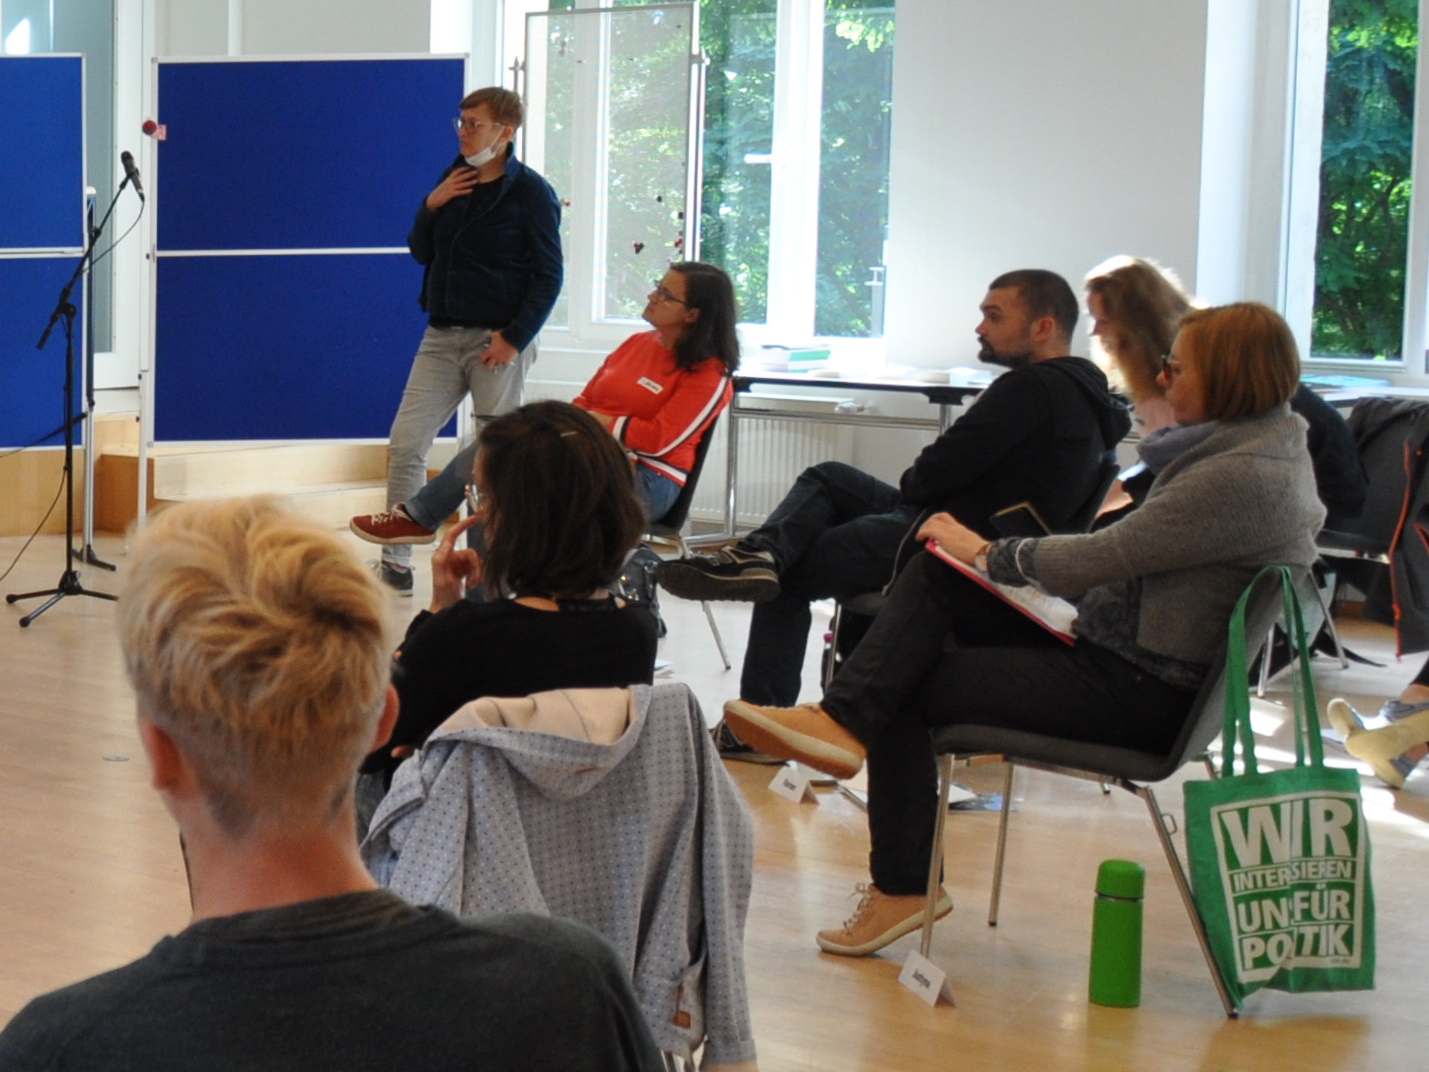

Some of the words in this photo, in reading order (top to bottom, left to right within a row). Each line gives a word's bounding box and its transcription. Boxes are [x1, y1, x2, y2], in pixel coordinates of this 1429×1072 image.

[1221, 798, 1353, 868] WIR
[1233, 859, 1353, 893] INTERSIEREN
[1238, 896, 1292, 933] UN
[1292, 883, 1350, 924] FÜR
